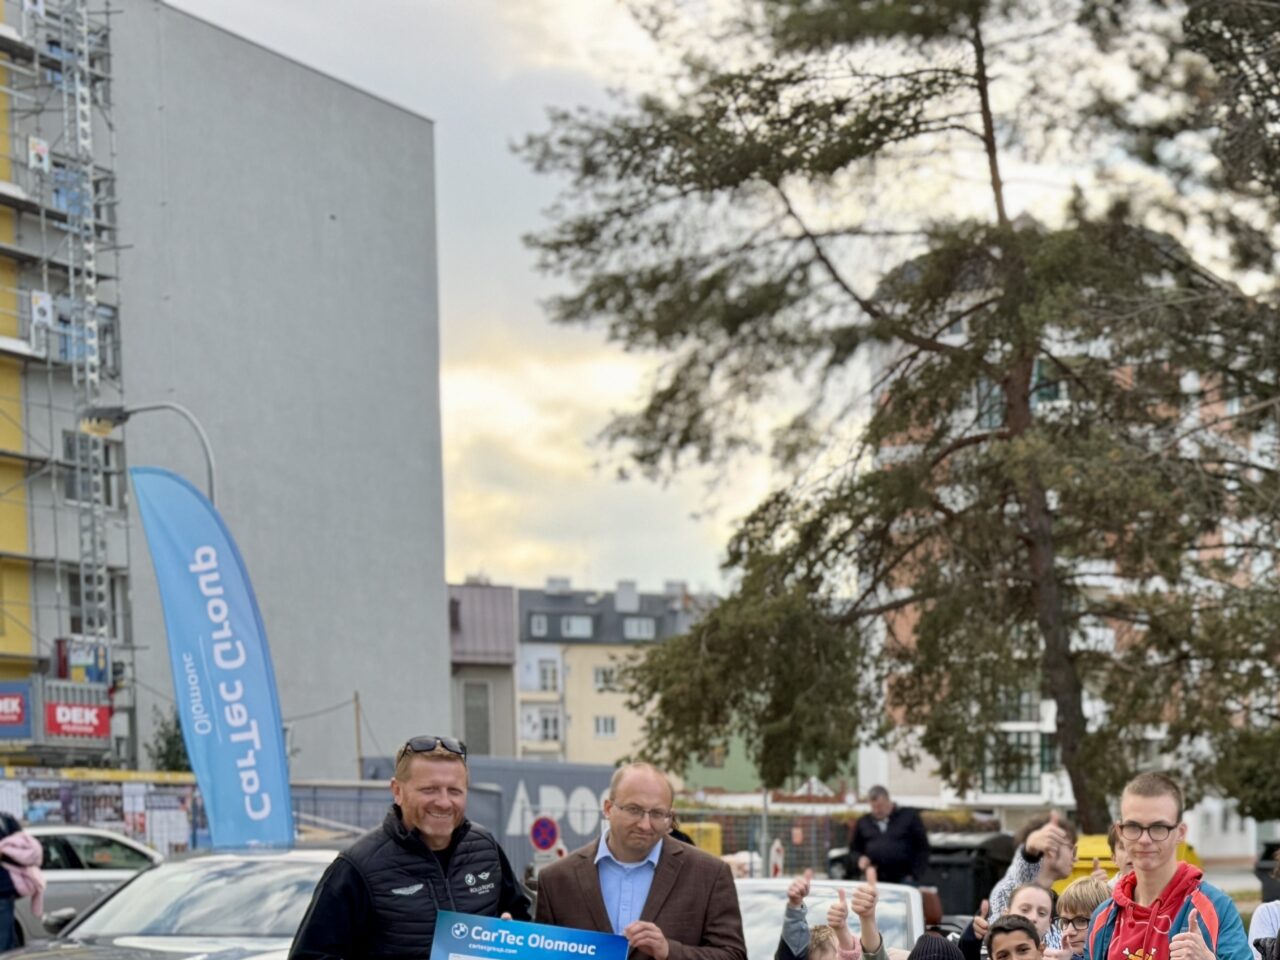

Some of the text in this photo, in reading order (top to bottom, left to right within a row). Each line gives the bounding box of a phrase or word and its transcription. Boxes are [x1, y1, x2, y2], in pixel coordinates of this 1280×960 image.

[56, 705, 99, 726] DEK
[471, 926, 597, 955] CarTec Olomouc
